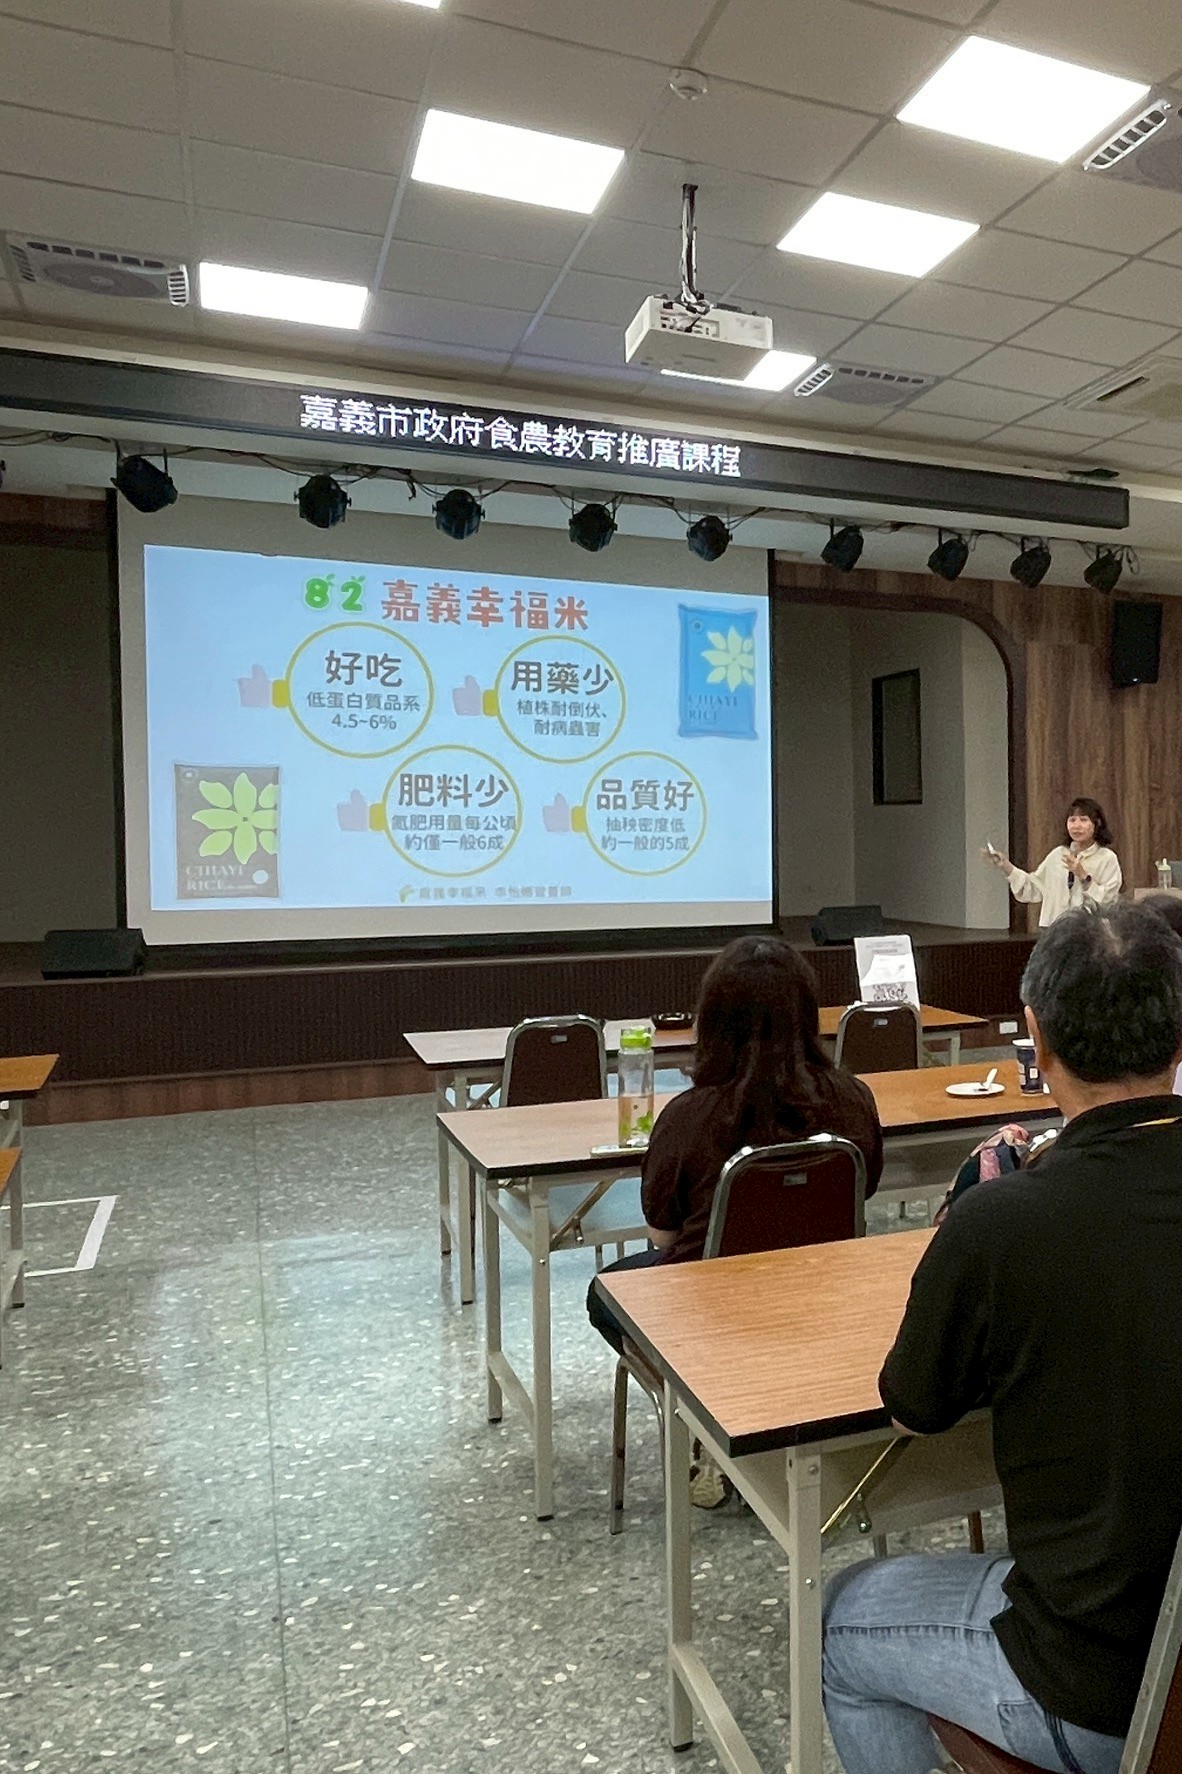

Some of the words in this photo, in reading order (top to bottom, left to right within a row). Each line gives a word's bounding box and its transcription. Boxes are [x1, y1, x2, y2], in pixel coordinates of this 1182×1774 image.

[300, 395, 742, 478] 嘉義市政府食農教育推廣課程
[381, 579, 588, 630] 嘉義幸福米
[325, 650, 402, 687] 好吃
[511, 661, 614, 695] 用藥少
[307, 691, 419, 712] 低蛋白質品系
[331, 714, 397, 730] 4.5~6%
[534, 719, 600, 737] 耐病蟲害
[398, 774, 509, 808] 肥料少
[597, 779, 694, 811] 品質好
[391, 814, 517, 831] 氮肥用量每公頃
[404, 834, 504, 850] 約僅一般6成
[601, 836, 690, 851] 約一般的5成
